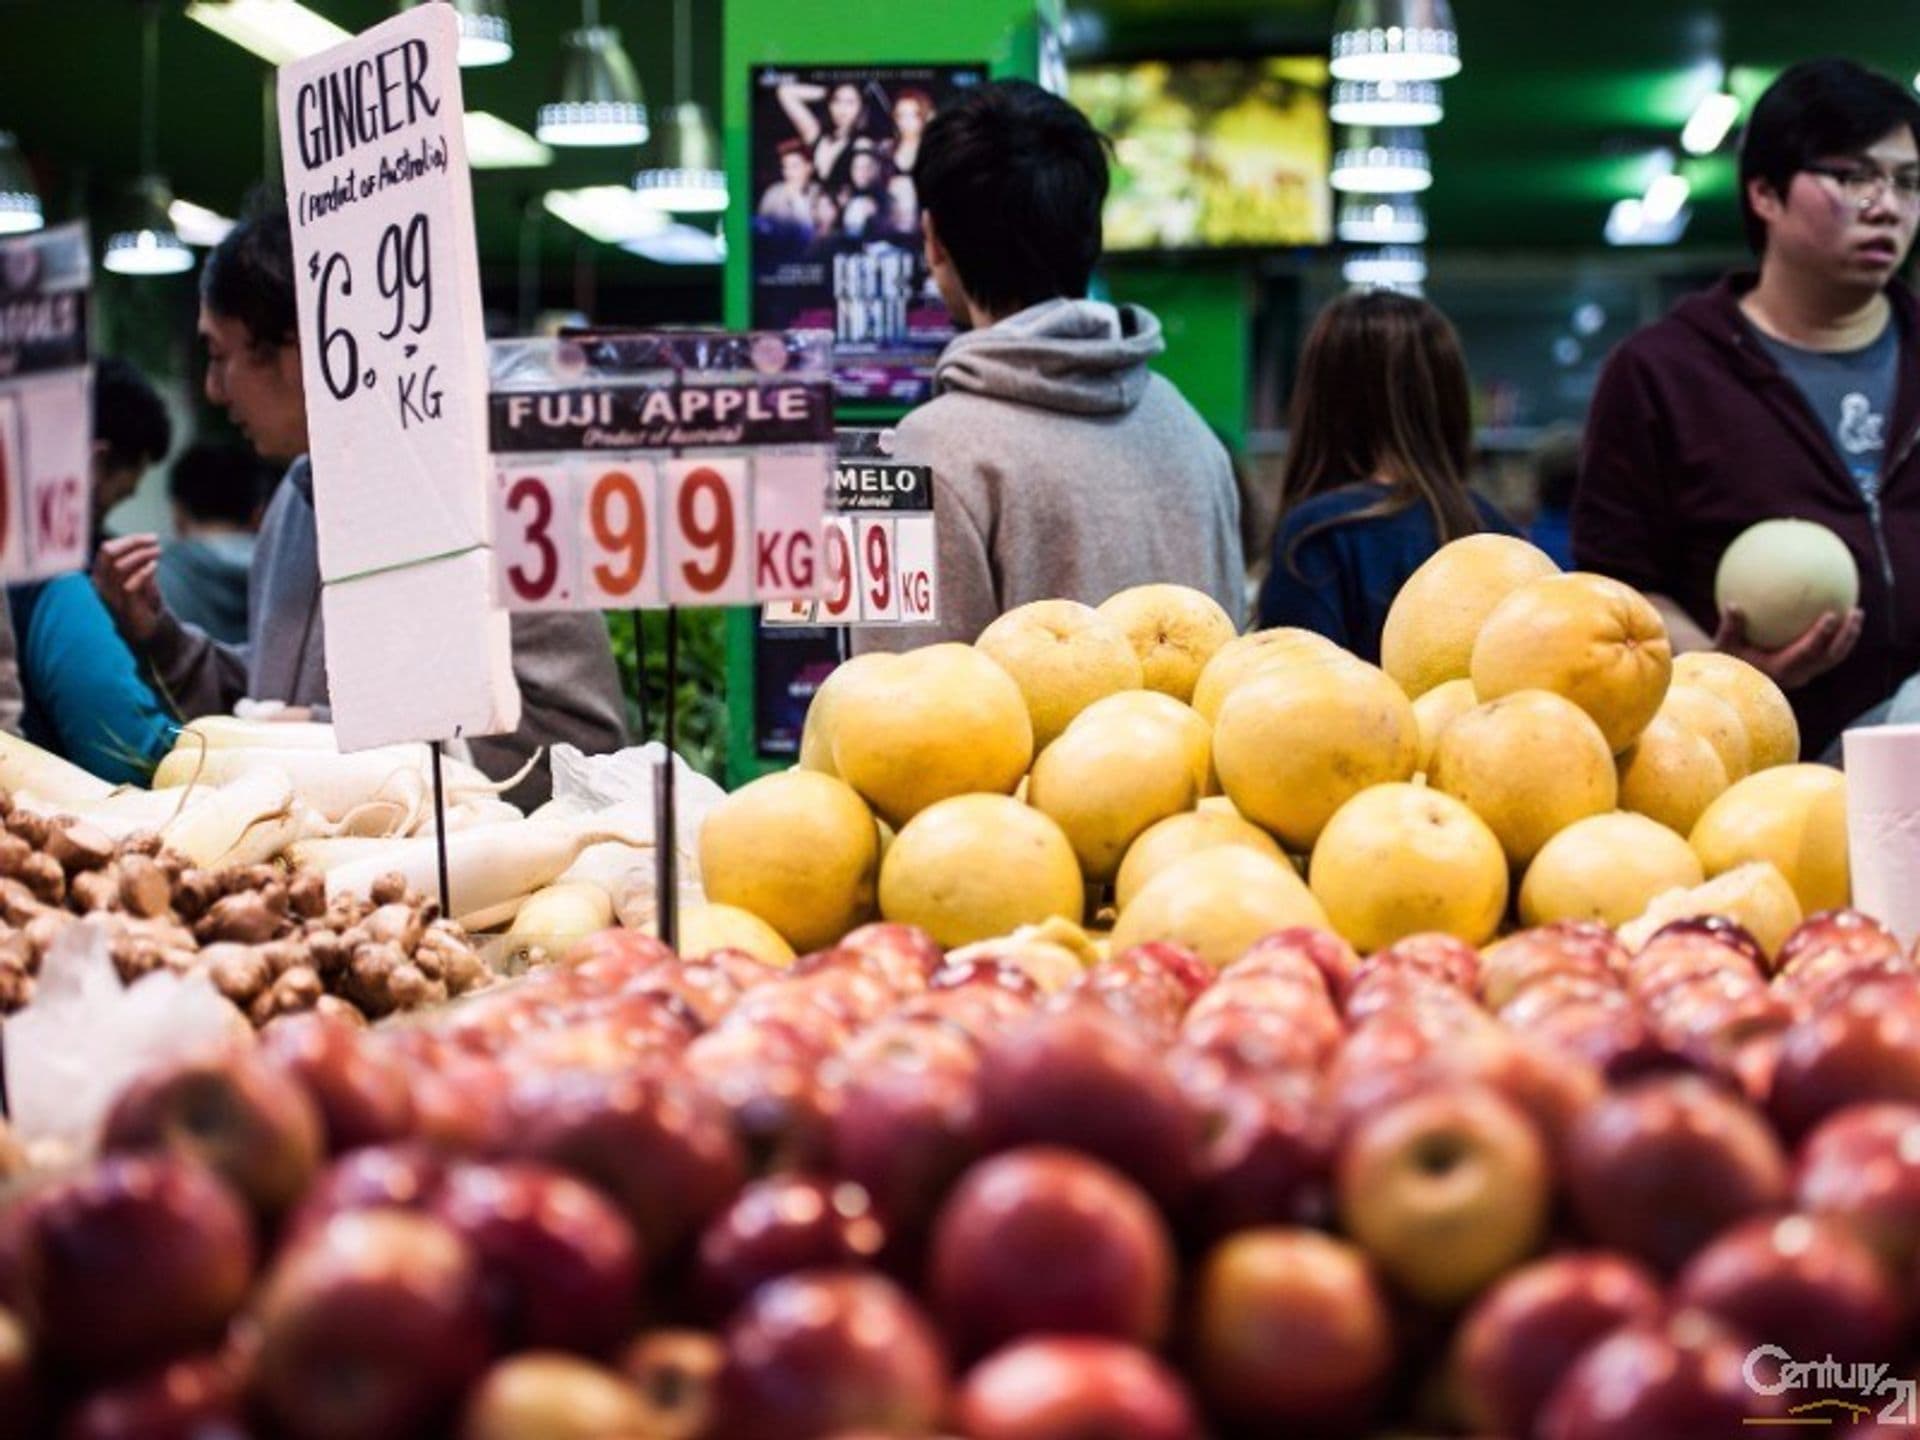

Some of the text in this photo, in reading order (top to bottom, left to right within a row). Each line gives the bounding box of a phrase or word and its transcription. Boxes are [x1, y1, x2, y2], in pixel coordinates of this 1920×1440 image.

[297, 38, 440, 170] GINGER
[397, 364, 444, 429] KG
[508, 396, 612, 428] FUJI
[640, 387, 809, 424] APPLE
[834, 467, 916, 493] MELO
[756, 530, 814, 588] KG
[902, 570, 930, 614] KG
